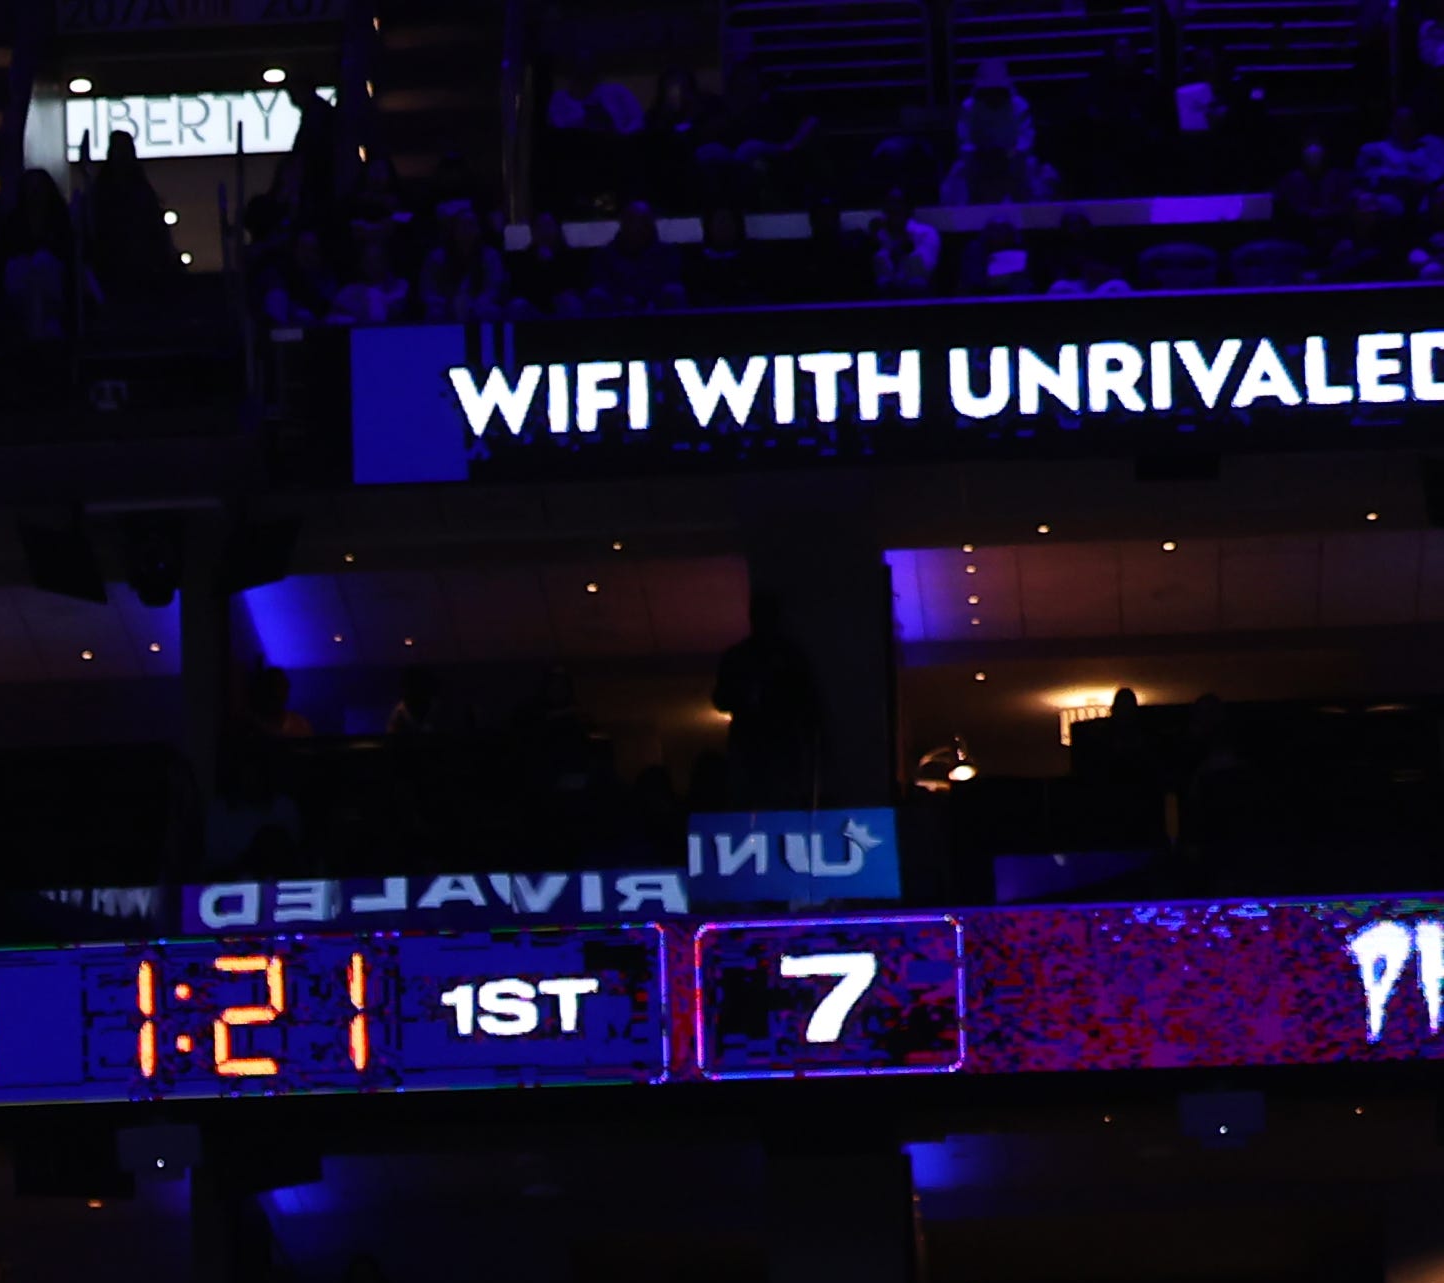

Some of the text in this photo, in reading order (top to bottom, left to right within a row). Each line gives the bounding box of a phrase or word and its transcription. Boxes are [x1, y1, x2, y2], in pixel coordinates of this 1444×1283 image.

[448, 360, 649, 437] WIFI
[673, 349, 921, 428] WITH
[137, 953, 368, 1078] 1:21
[440, 978, 599, 1037] 1ST
[779, 952, 877, 1044] 7
